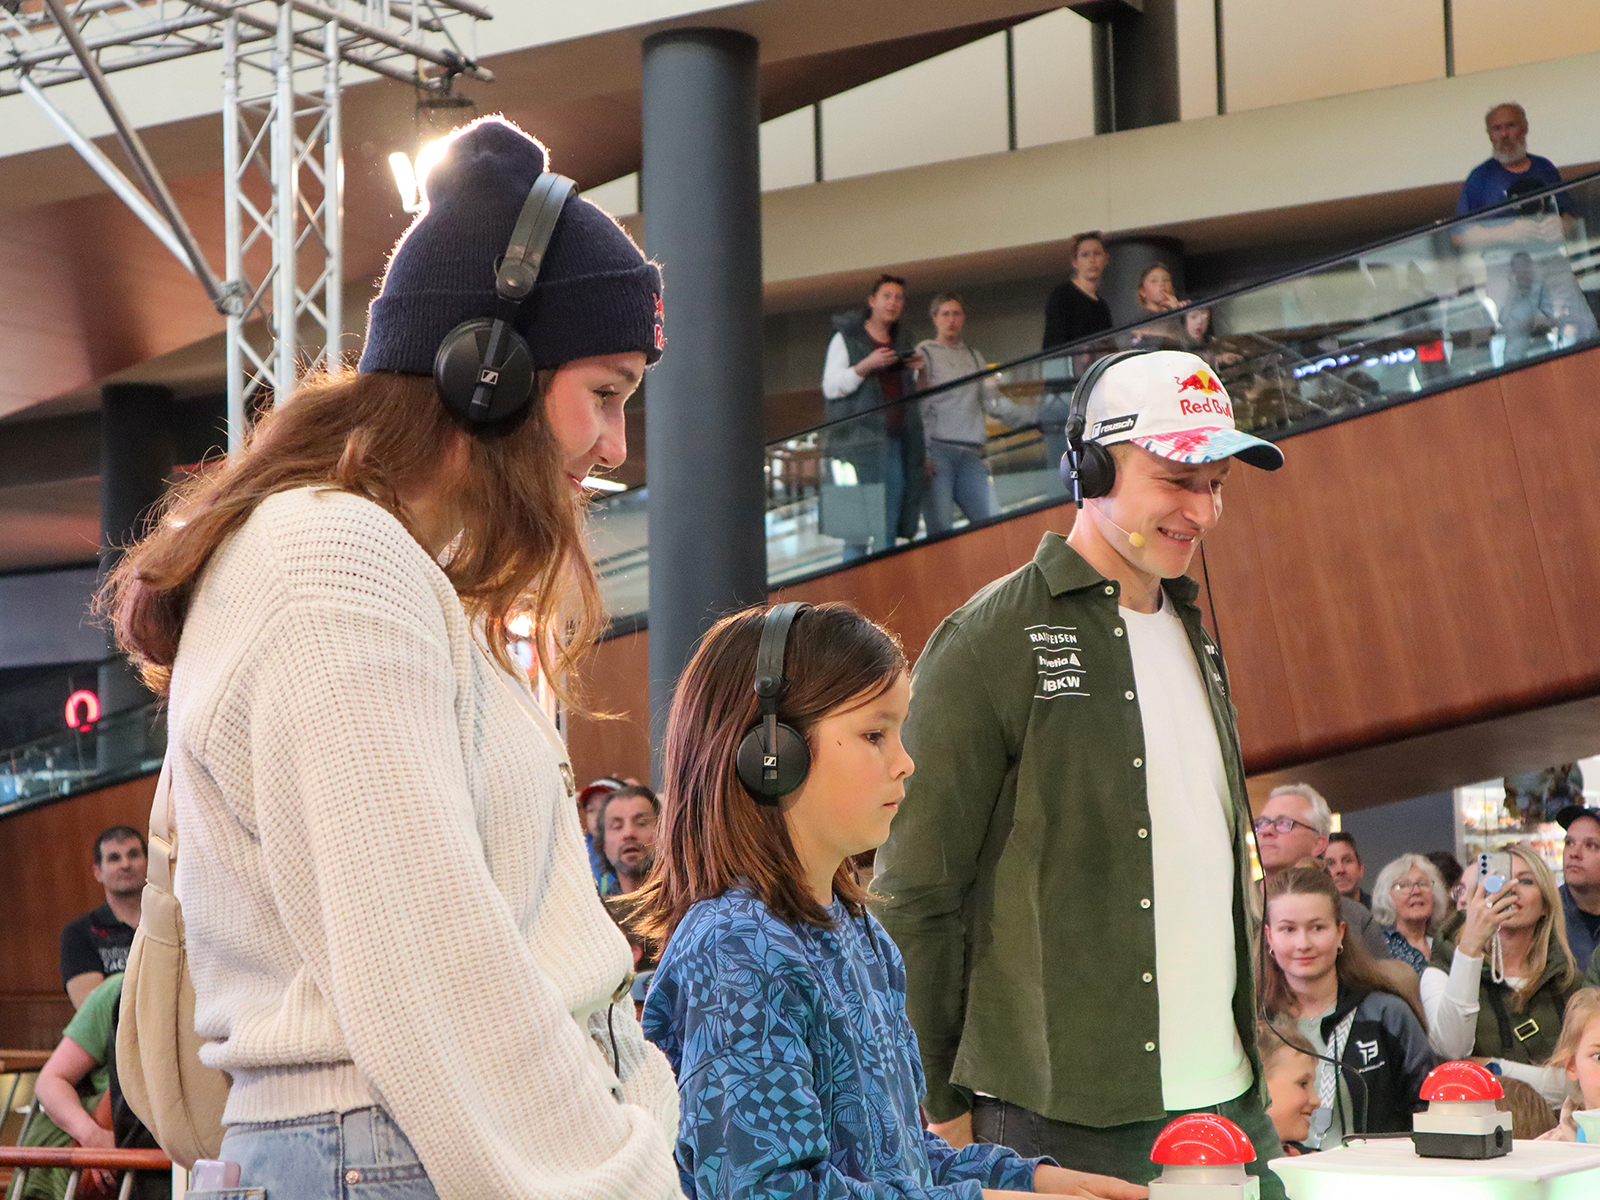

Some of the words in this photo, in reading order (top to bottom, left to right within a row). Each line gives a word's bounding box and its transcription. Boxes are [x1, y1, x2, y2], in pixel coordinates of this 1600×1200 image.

[1180, 397, 1212, 415] Red
[1212, 398, 1233, 419] Bul
[1100, 418, 1134, 433] reusch
